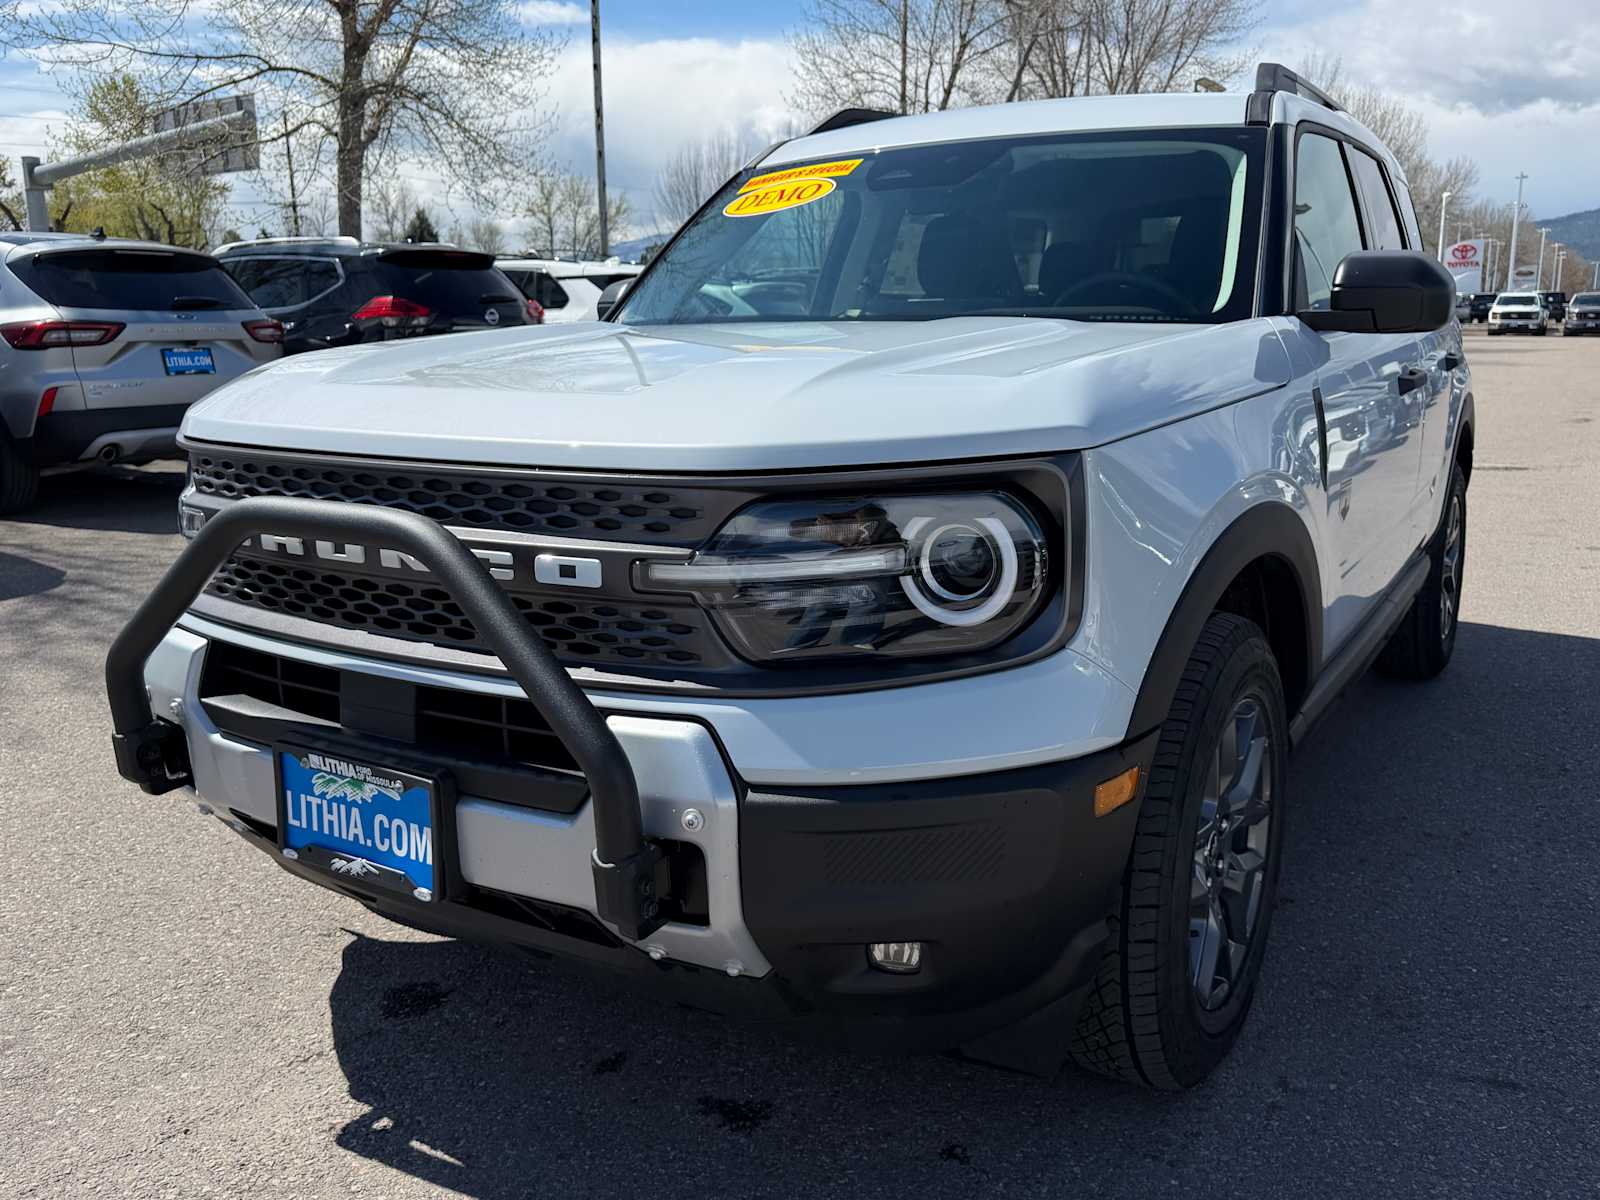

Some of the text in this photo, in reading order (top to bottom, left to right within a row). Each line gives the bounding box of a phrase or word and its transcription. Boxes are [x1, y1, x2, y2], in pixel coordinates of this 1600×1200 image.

[735, 184, 823, 212] DEMO
[1447, 260, 1480, 269] TOYOTA
[165, 355, 213, 368] LITHIA.COM
[319, 755, 356, 778] LITHIA
[286, 790, 433, 865] LITHIA.COM
